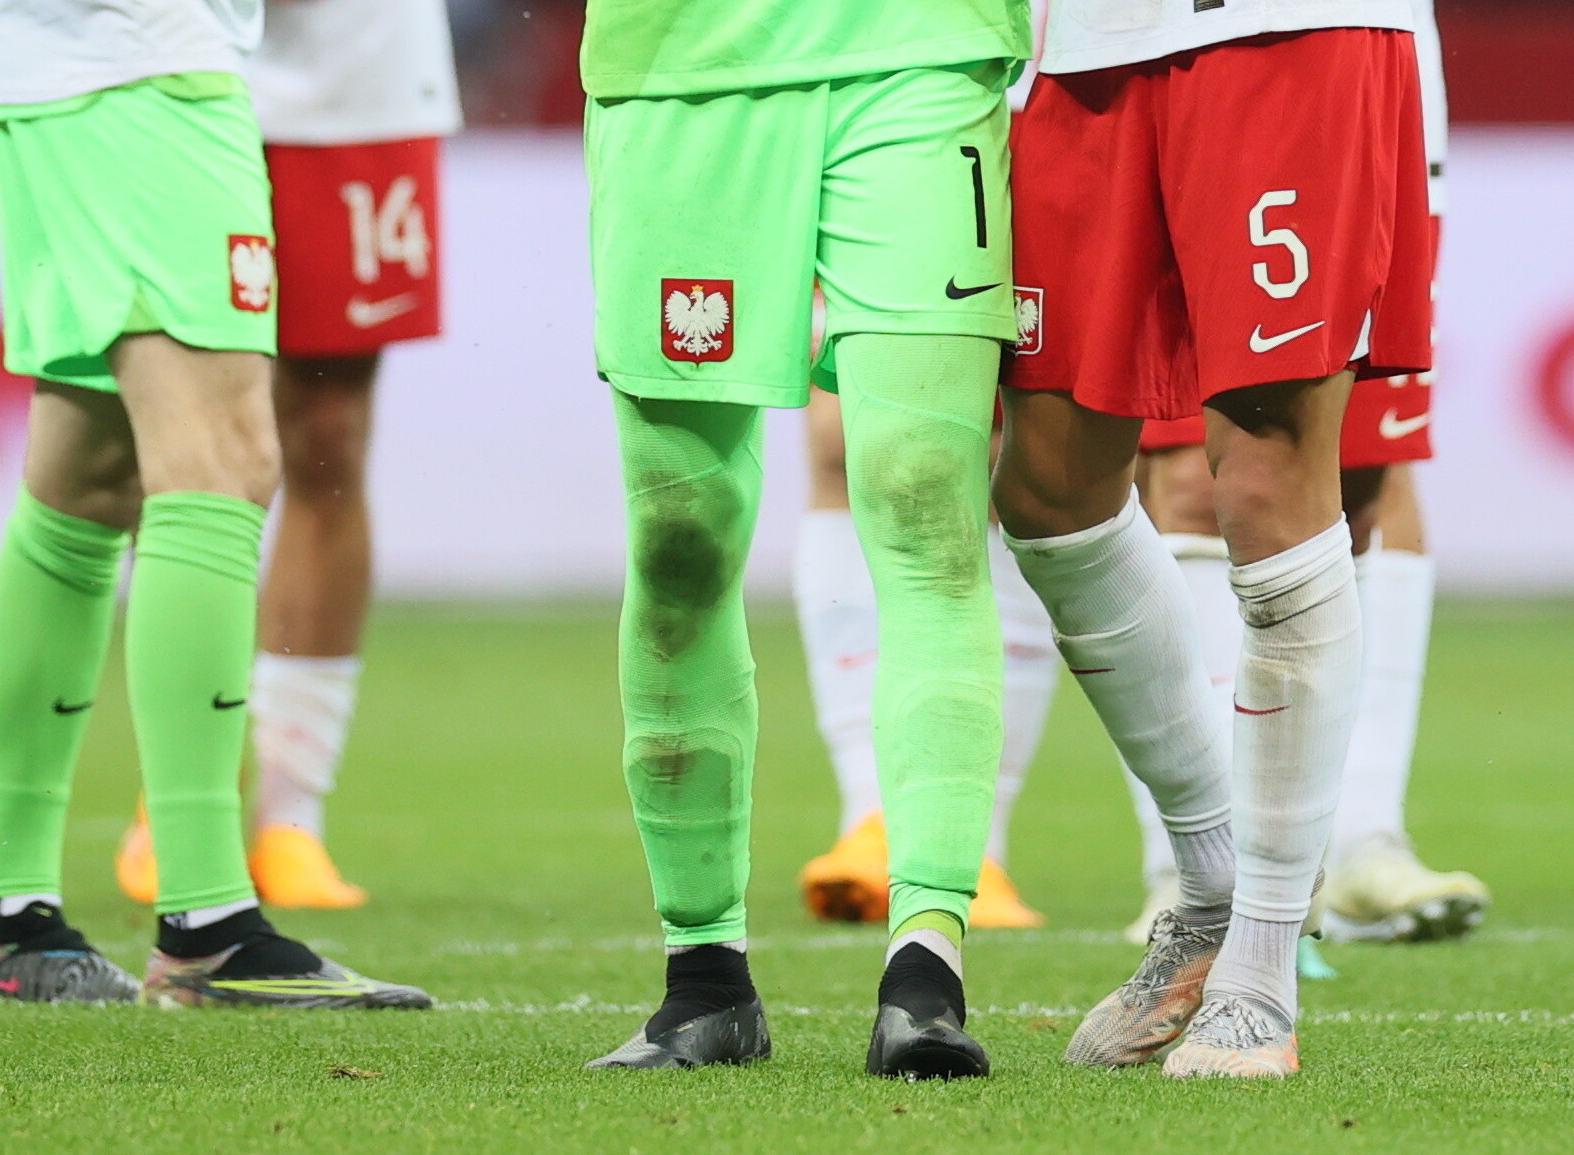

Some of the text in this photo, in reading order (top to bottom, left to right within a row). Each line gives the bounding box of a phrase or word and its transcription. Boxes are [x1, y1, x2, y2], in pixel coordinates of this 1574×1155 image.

[340, 174, 431, 285] 14
[960, 146, 987, 248] 1
[1249, 189, 1310, 299] 5
